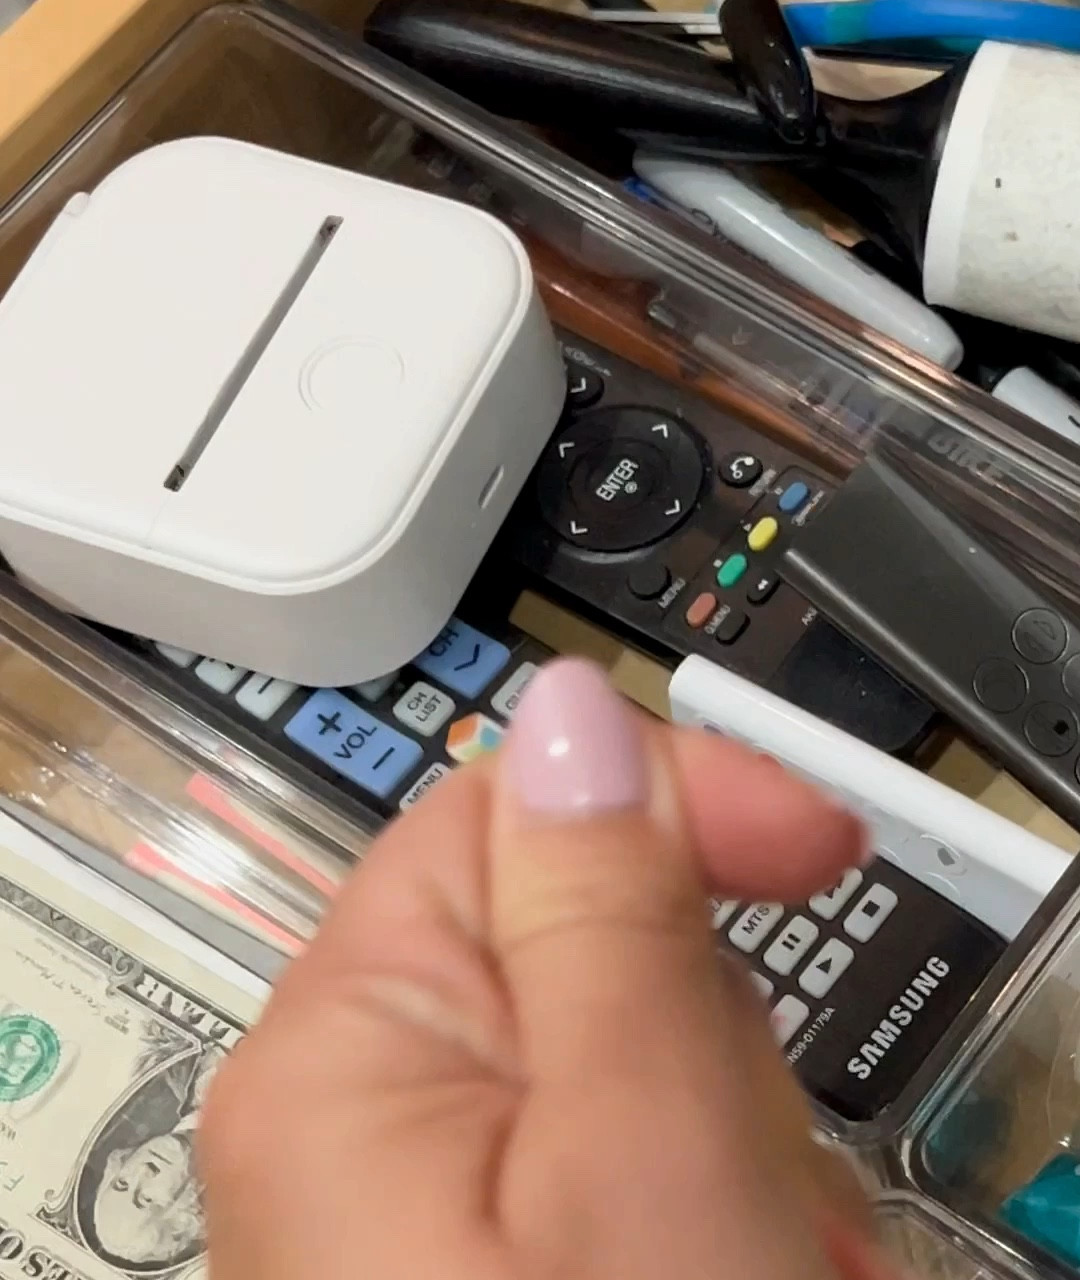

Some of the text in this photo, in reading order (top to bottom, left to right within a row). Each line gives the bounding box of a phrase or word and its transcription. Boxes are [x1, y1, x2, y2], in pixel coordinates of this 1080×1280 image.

[595, 457, 640, 503] ENTER
[407, 691, 427, 712] CH
[415, 693, 443, 723] LIST
[333, 723, 379, 761] VOL
[741, 902, 771, 935] MTS
[787, 1006, 837, 1066] N59-01179A
[846, 955, 952, 1081] SAMSUNG
